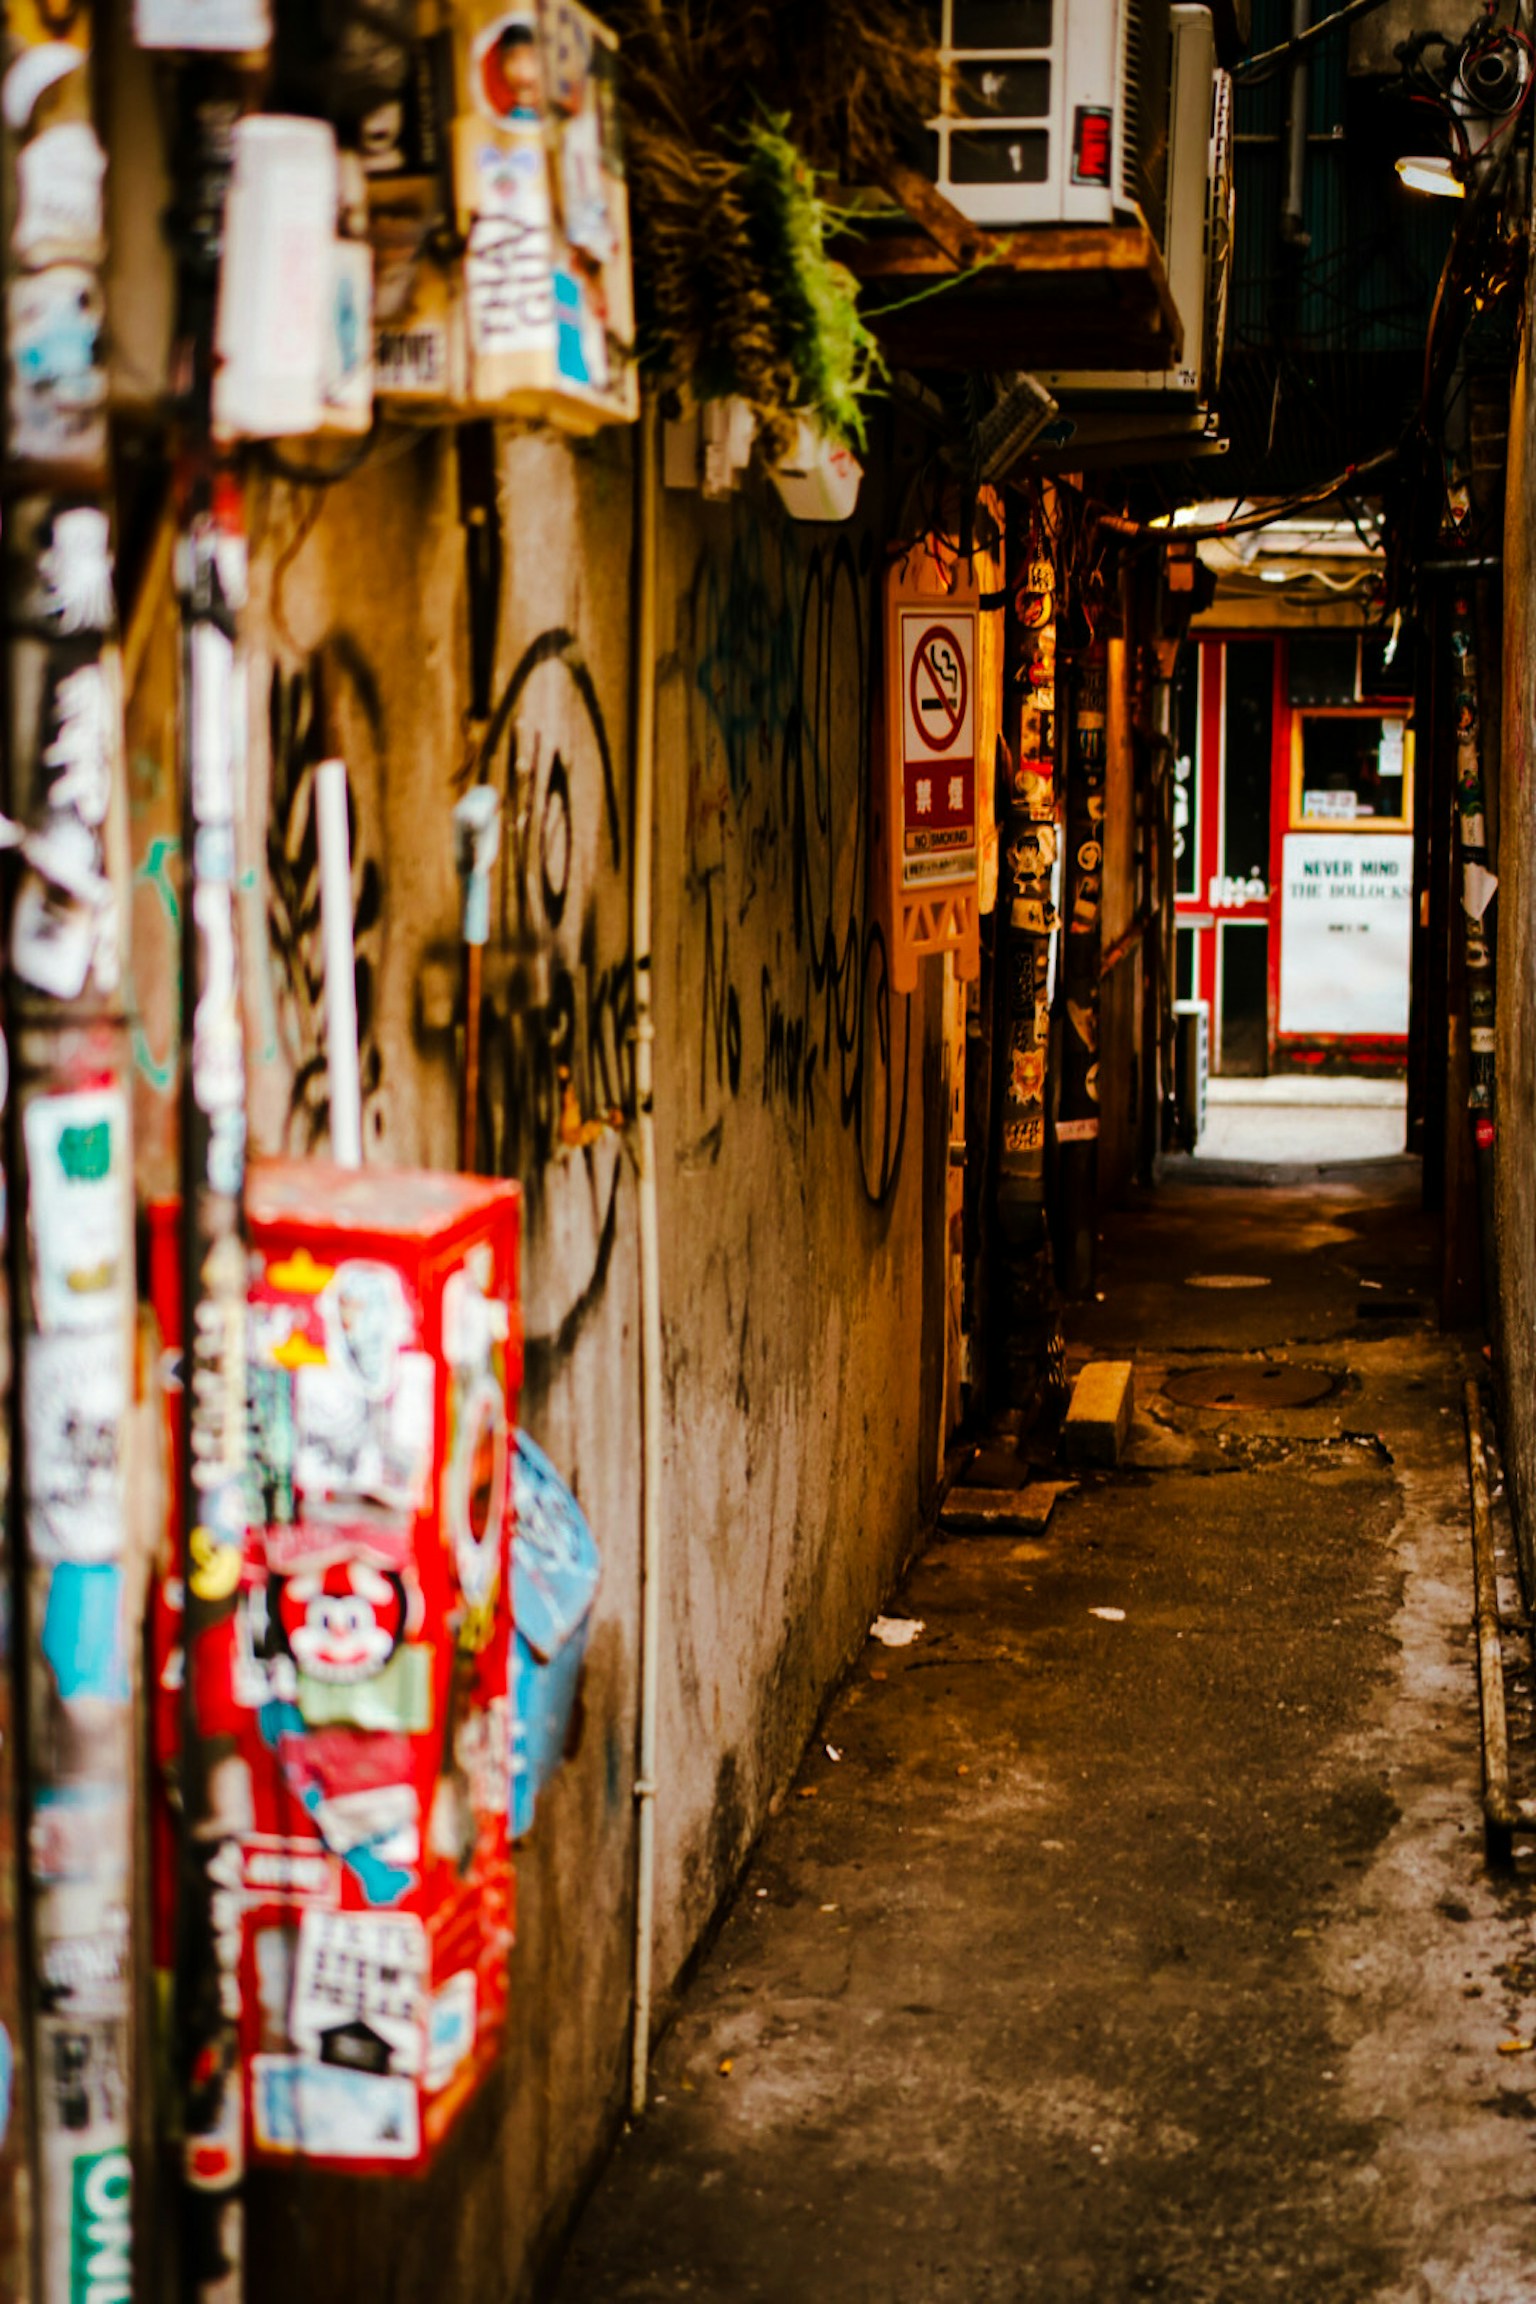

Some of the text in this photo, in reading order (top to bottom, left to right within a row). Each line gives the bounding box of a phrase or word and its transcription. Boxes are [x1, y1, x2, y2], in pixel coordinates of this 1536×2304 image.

[914, 829, 968, 849] NO SMOKING
[1303, 860, 1399, 877] NEVER MIND
[1291, 882, 1410, 900] THE BOLLOCKS
